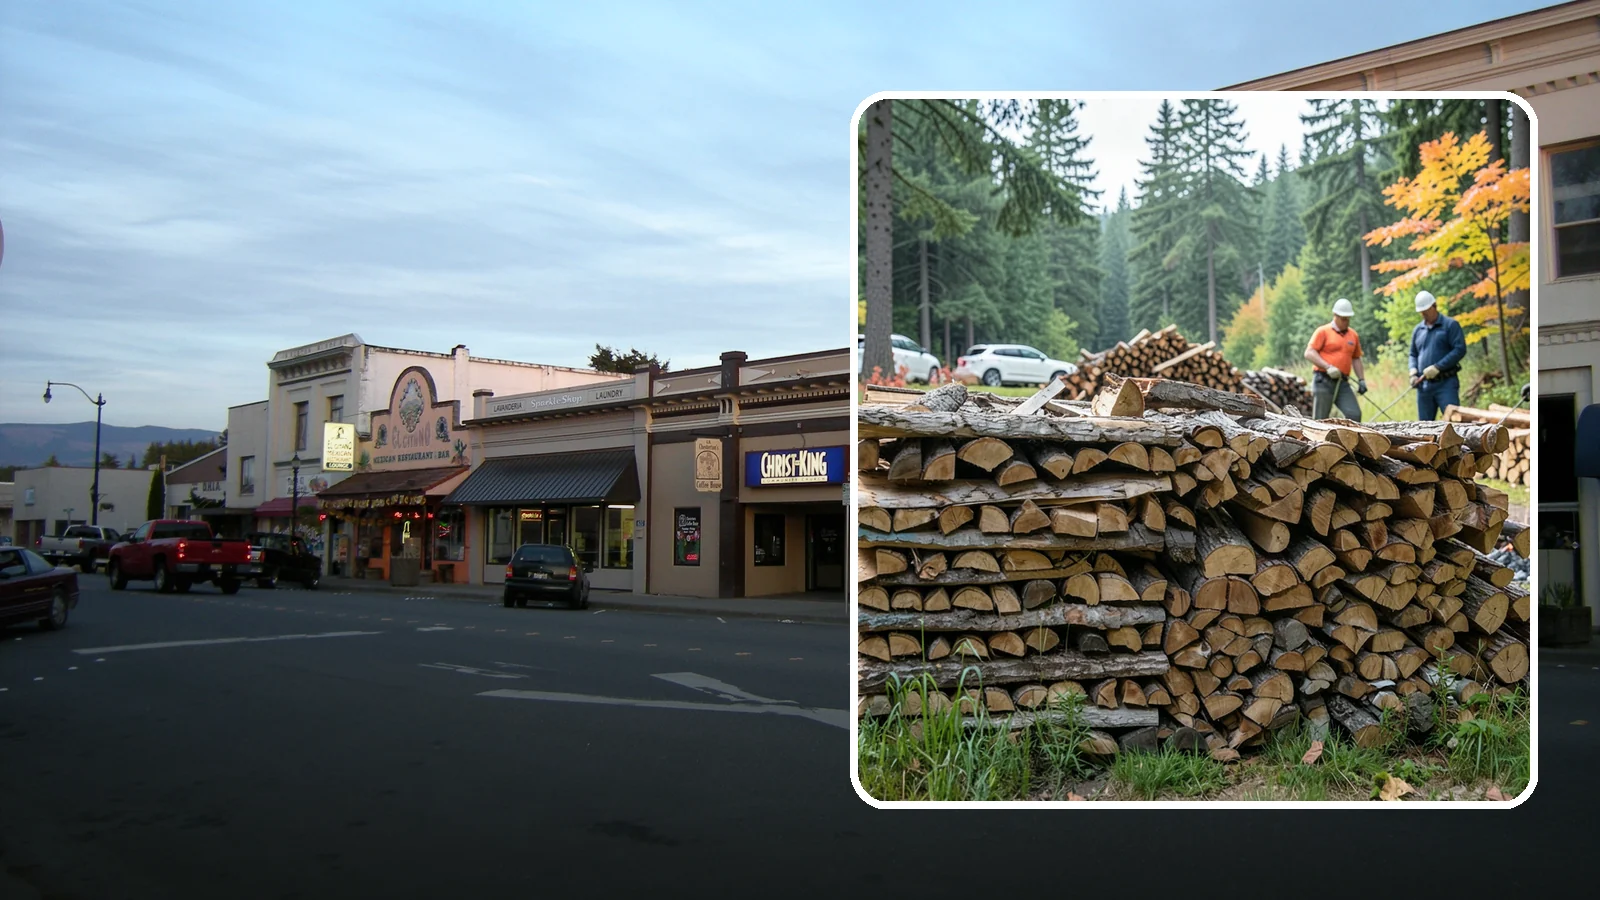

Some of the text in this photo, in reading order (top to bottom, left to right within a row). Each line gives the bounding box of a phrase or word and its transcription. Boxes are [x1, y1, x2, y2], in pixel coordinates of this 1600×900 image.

[494, 402, 522, 413] LAVANDERIA
[562, 395, 583, 405] Shop
[596, 389, 624, 400] LAUNDRY
[374, 455, 396, 464] MEXICAN
[398, 451, 434, 462] RESTAURANT
[438, 450, 450, 459] BAR
[761, 450, 828, 478] CHRIST KING
